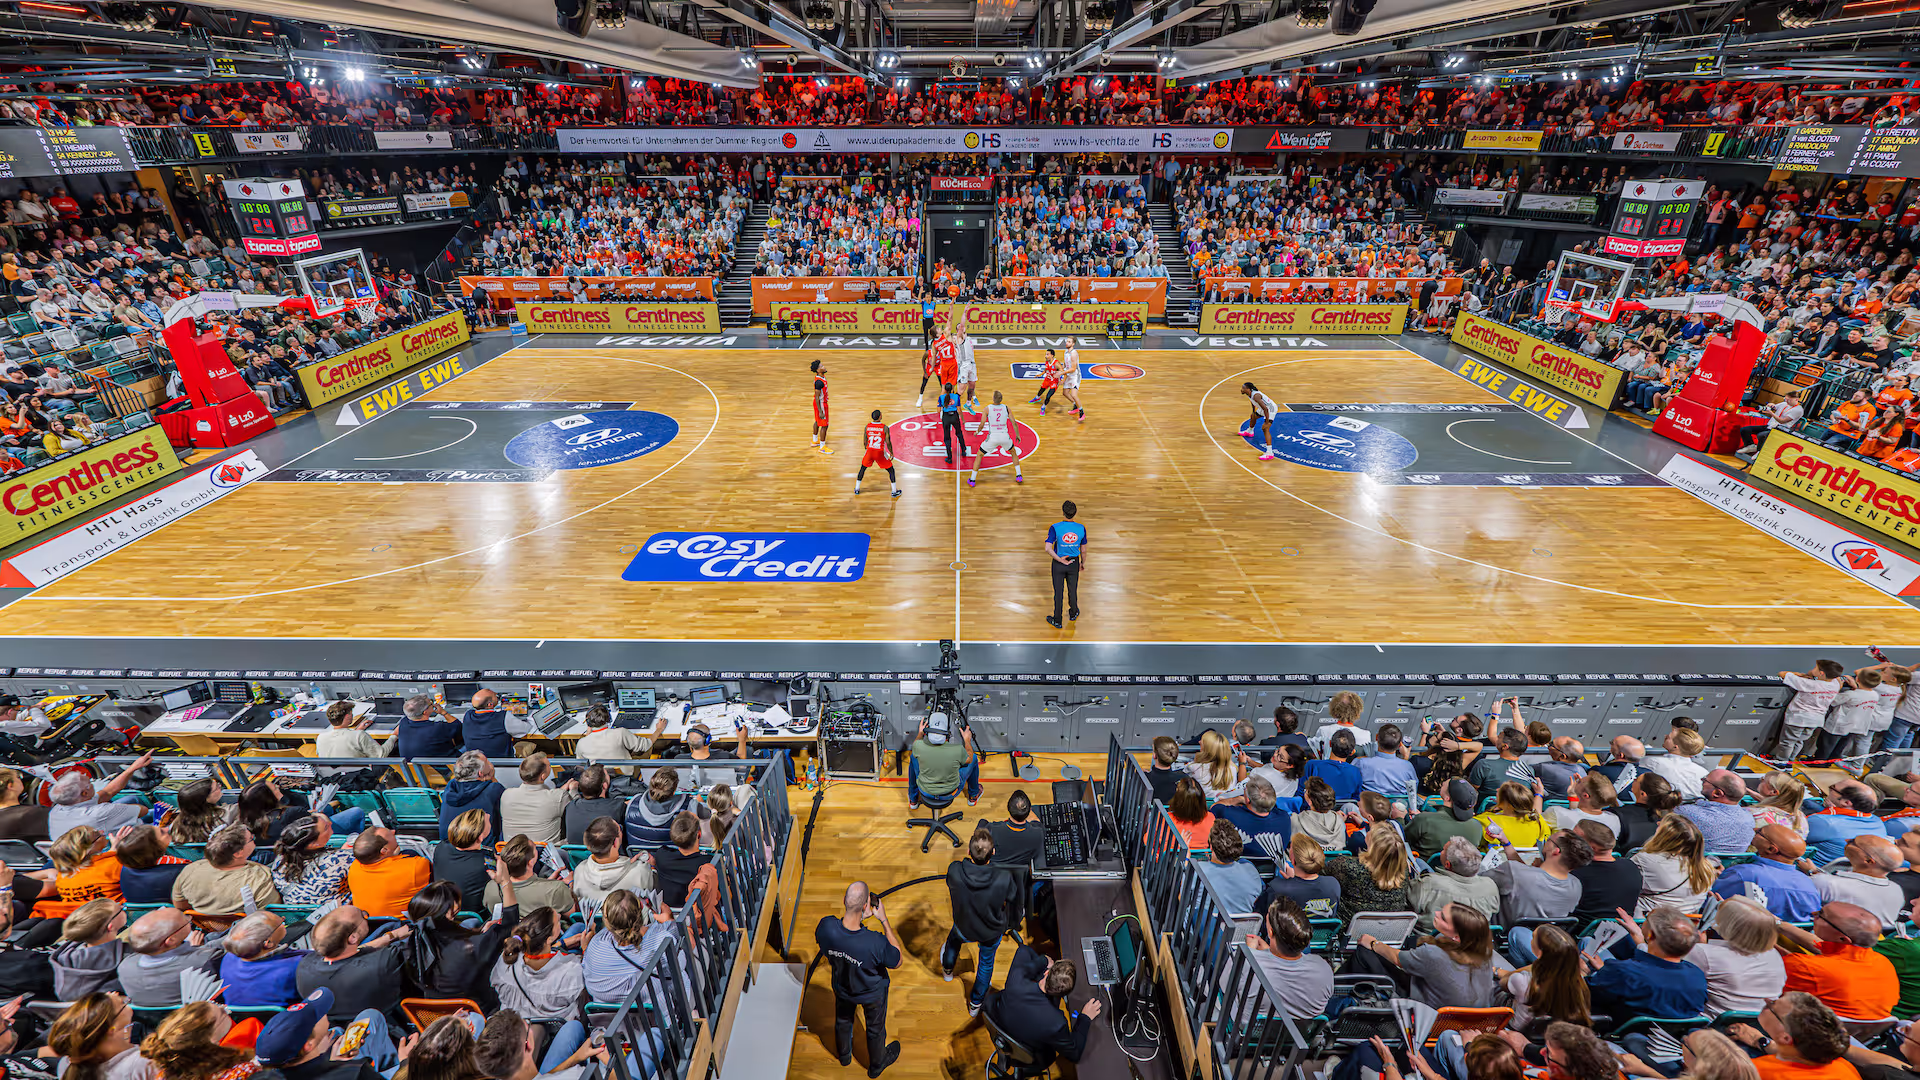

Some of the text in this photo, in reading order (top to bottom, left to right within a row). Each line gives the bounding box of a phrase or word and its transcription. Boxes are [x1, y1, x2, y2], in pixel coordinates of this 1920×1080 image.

[198, 136, 209, 148] E
[570, 137, 584, 145] Der
[586, 136, 630, 145] Heimvorteil
[632, 136, 644, 145] für
[646, 136, 698, 145] Unternehmen
[700, 136, 712, 145] der
[982, 133, 1001, 148] HS
[1053, 136, 1140, 146] www.hs-vechta.de
[1153, 133, 1172, 148] HS
[1881, 136, 1919, 144] GRÜNLOH
[343, 204, 357, 213] DEIN
[251, 217, 276, 233] 24
[1659, 219, 1683, 235] 24
[248, 240, 284, 253] tipico
[289, 239, 318, 252] tipico
[1609, 239, 1638, 253] tipico
[1644, 242, 1682, 255] tipico
[406, 335, 461, 363] FITNESSCENTER
[596, 335, 739, 347] VECHTA
[819, 336, 930, 346] RAST
[1179, 337, 1328, 347] VECHTA
[941, 346, 952, 357] 17
[1460, 336, 1515, 363] FITNESSCENTER
[323, 363, 395, 397] FITNESSCENTER
[420, 357, 463, 390] EWE
[1458, 359, 1508, 392] EWE
[1527, 363, 1598, 399] FITNESSCENTER
[1701, 371, 1712, 379] LzO
[360, 382, 413, 420] EWE
[1509, 385, 1569, 421] EWE
[238, 411, 254, 423] LzO
[1675, 414, 1692, 426] LzO
[564, 432, 643, 455] HYUNDAI
[868, 436, 882, 446] 12
[1277, 434, 1358, 458] HYUNDAI
[216, 461, 256, 484] HTL
[319, 470, 391, 481] Purtec
[17, 461, 164, 531] FITNESSCENTER
[1719, 478, 1787, 515] HTL Hass
[1766, 467, 1917, 538] FITNESSCENTER
[86, 496, 162, 536] HTL Hass
[1670, 471, 1826, 553] Transport & Logistik GmbH
[41, 487, 217, 576] Transport & Logistik GmbH
[648, 535, 786, 559] e@sy
[700, 555, 859, 578] Credit
[1841, 548, 1891, 581] HTL
[828, 949, 862, 967] SECURITY
